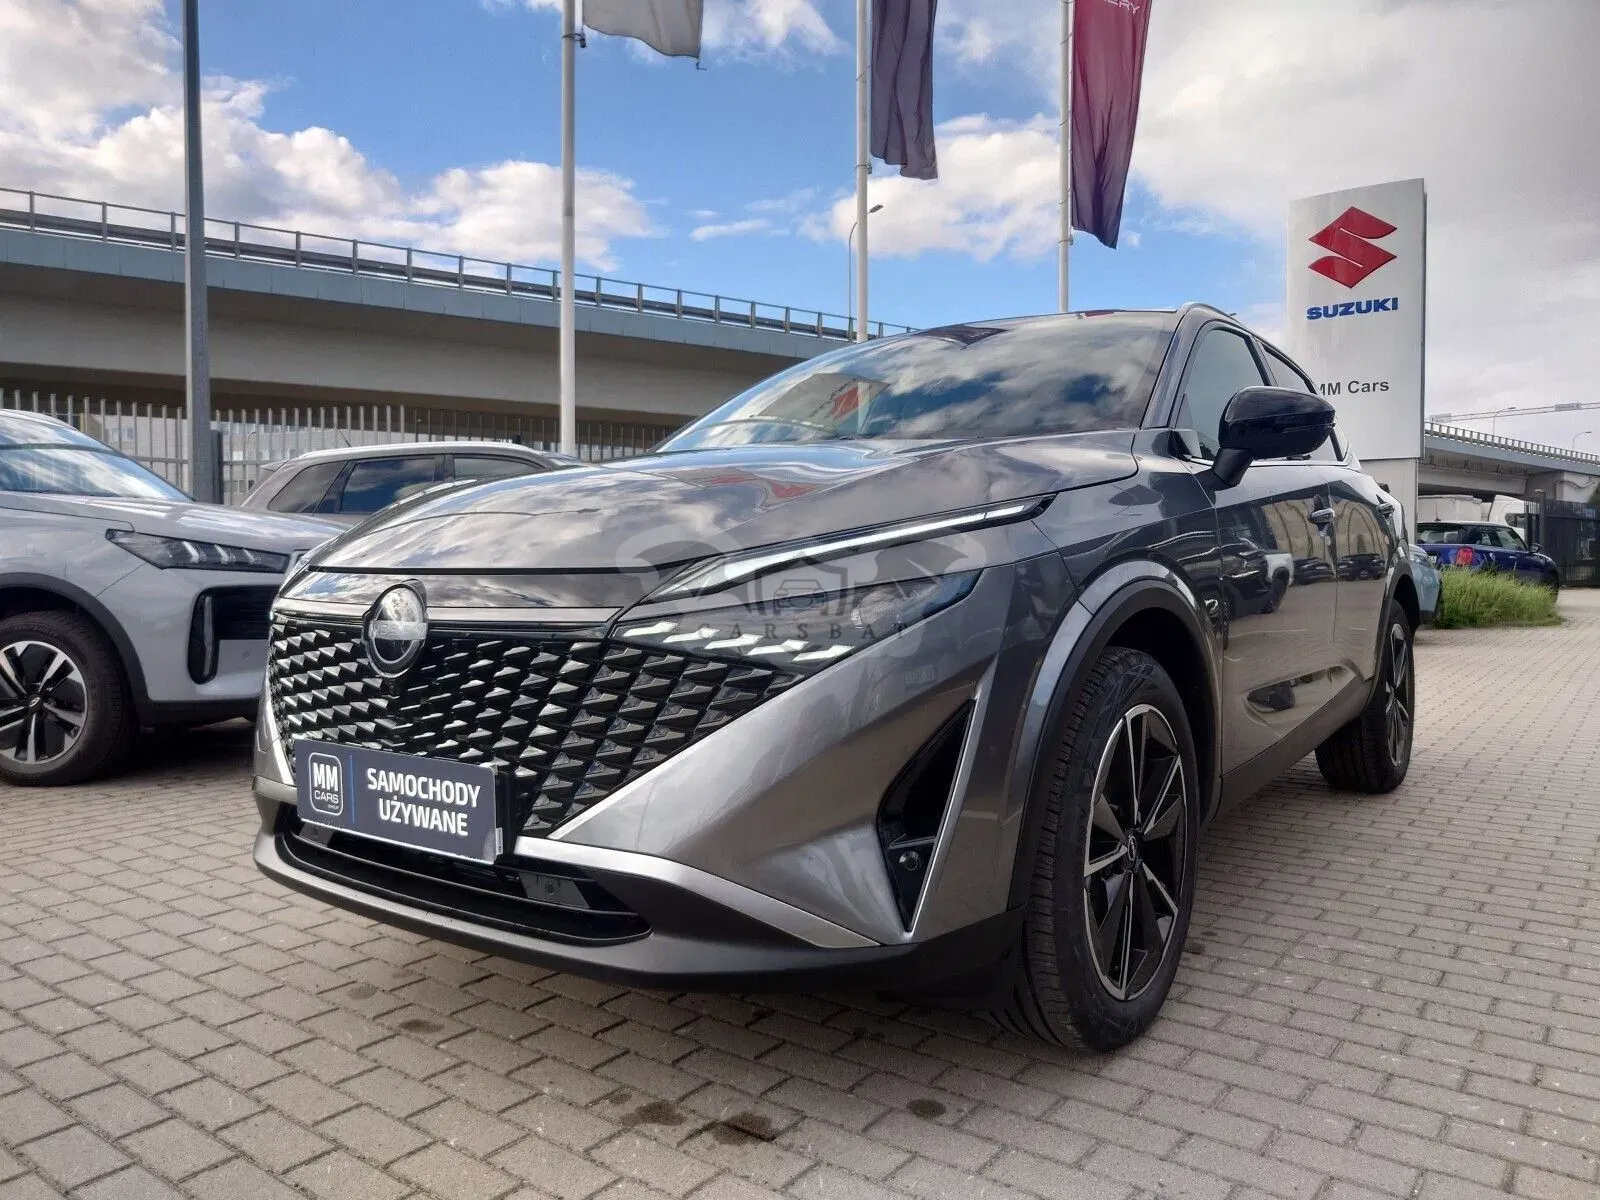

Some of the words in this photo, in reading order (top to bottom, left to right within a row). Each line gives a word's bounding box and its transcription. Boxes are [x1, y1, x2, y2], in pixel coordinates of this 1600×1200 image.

[1306, 297, 1399, 320] SUZUKI
[1347, 380, 1390, 394] Cars
[313, 762, 338, 791] MM
[367, 767, 481, 808] SAMOCHODY
[314, 790, 339, 804] CARS
[379, 795, 469, 837] UŻYWANE
